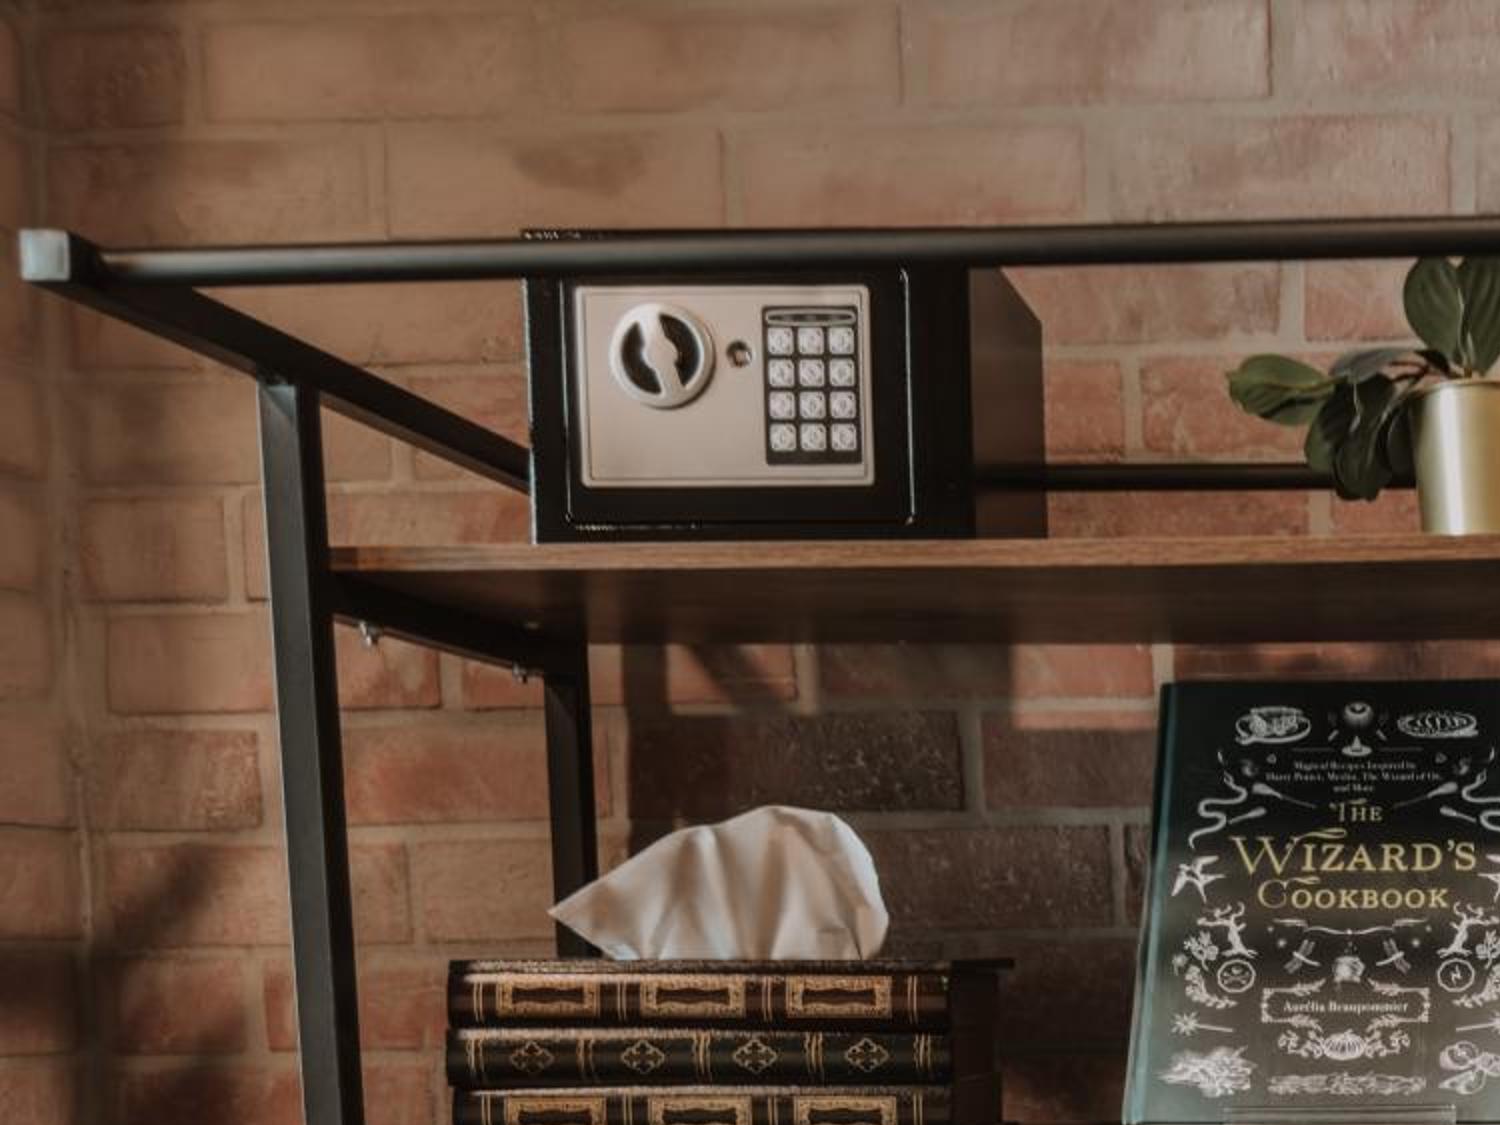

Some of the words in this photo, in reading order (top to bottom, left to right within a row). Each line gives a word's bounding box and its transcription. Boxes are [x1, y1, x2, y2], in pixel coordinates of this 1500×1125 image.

[1328, 799, 1383, 822] THE
[1229, 829, 1478, 875] WIZARD'S
[1257, 875, 1449, 910] COOKBOOK
